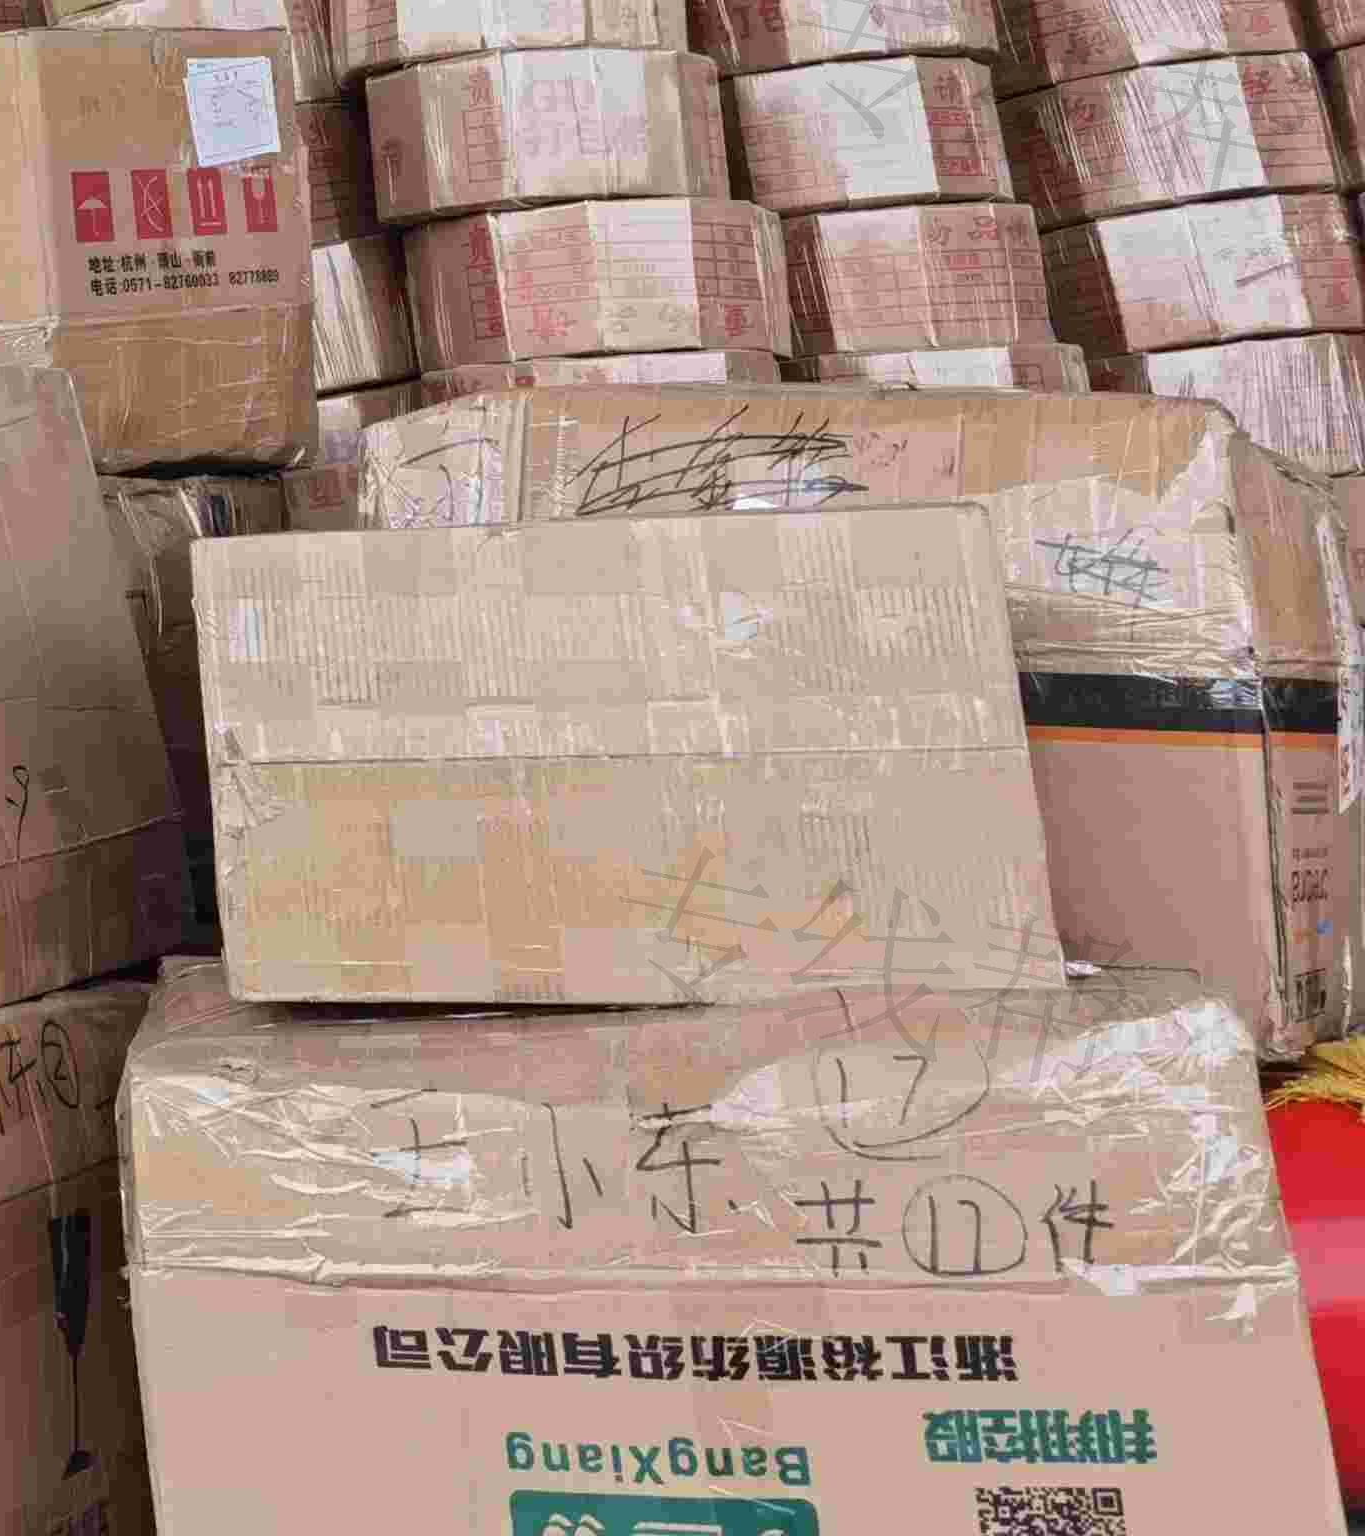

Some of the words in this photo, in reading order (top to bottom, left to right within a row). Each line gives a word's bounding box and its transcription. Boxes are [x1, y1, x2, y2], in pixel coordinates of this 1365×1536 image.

[369, 1322, 1018, 1382] 浙江裕源纺织有限公司
[503, 1430, 810, 1490] BangXiang
[921, 1407, 1158, 1465] 邦翔控股
